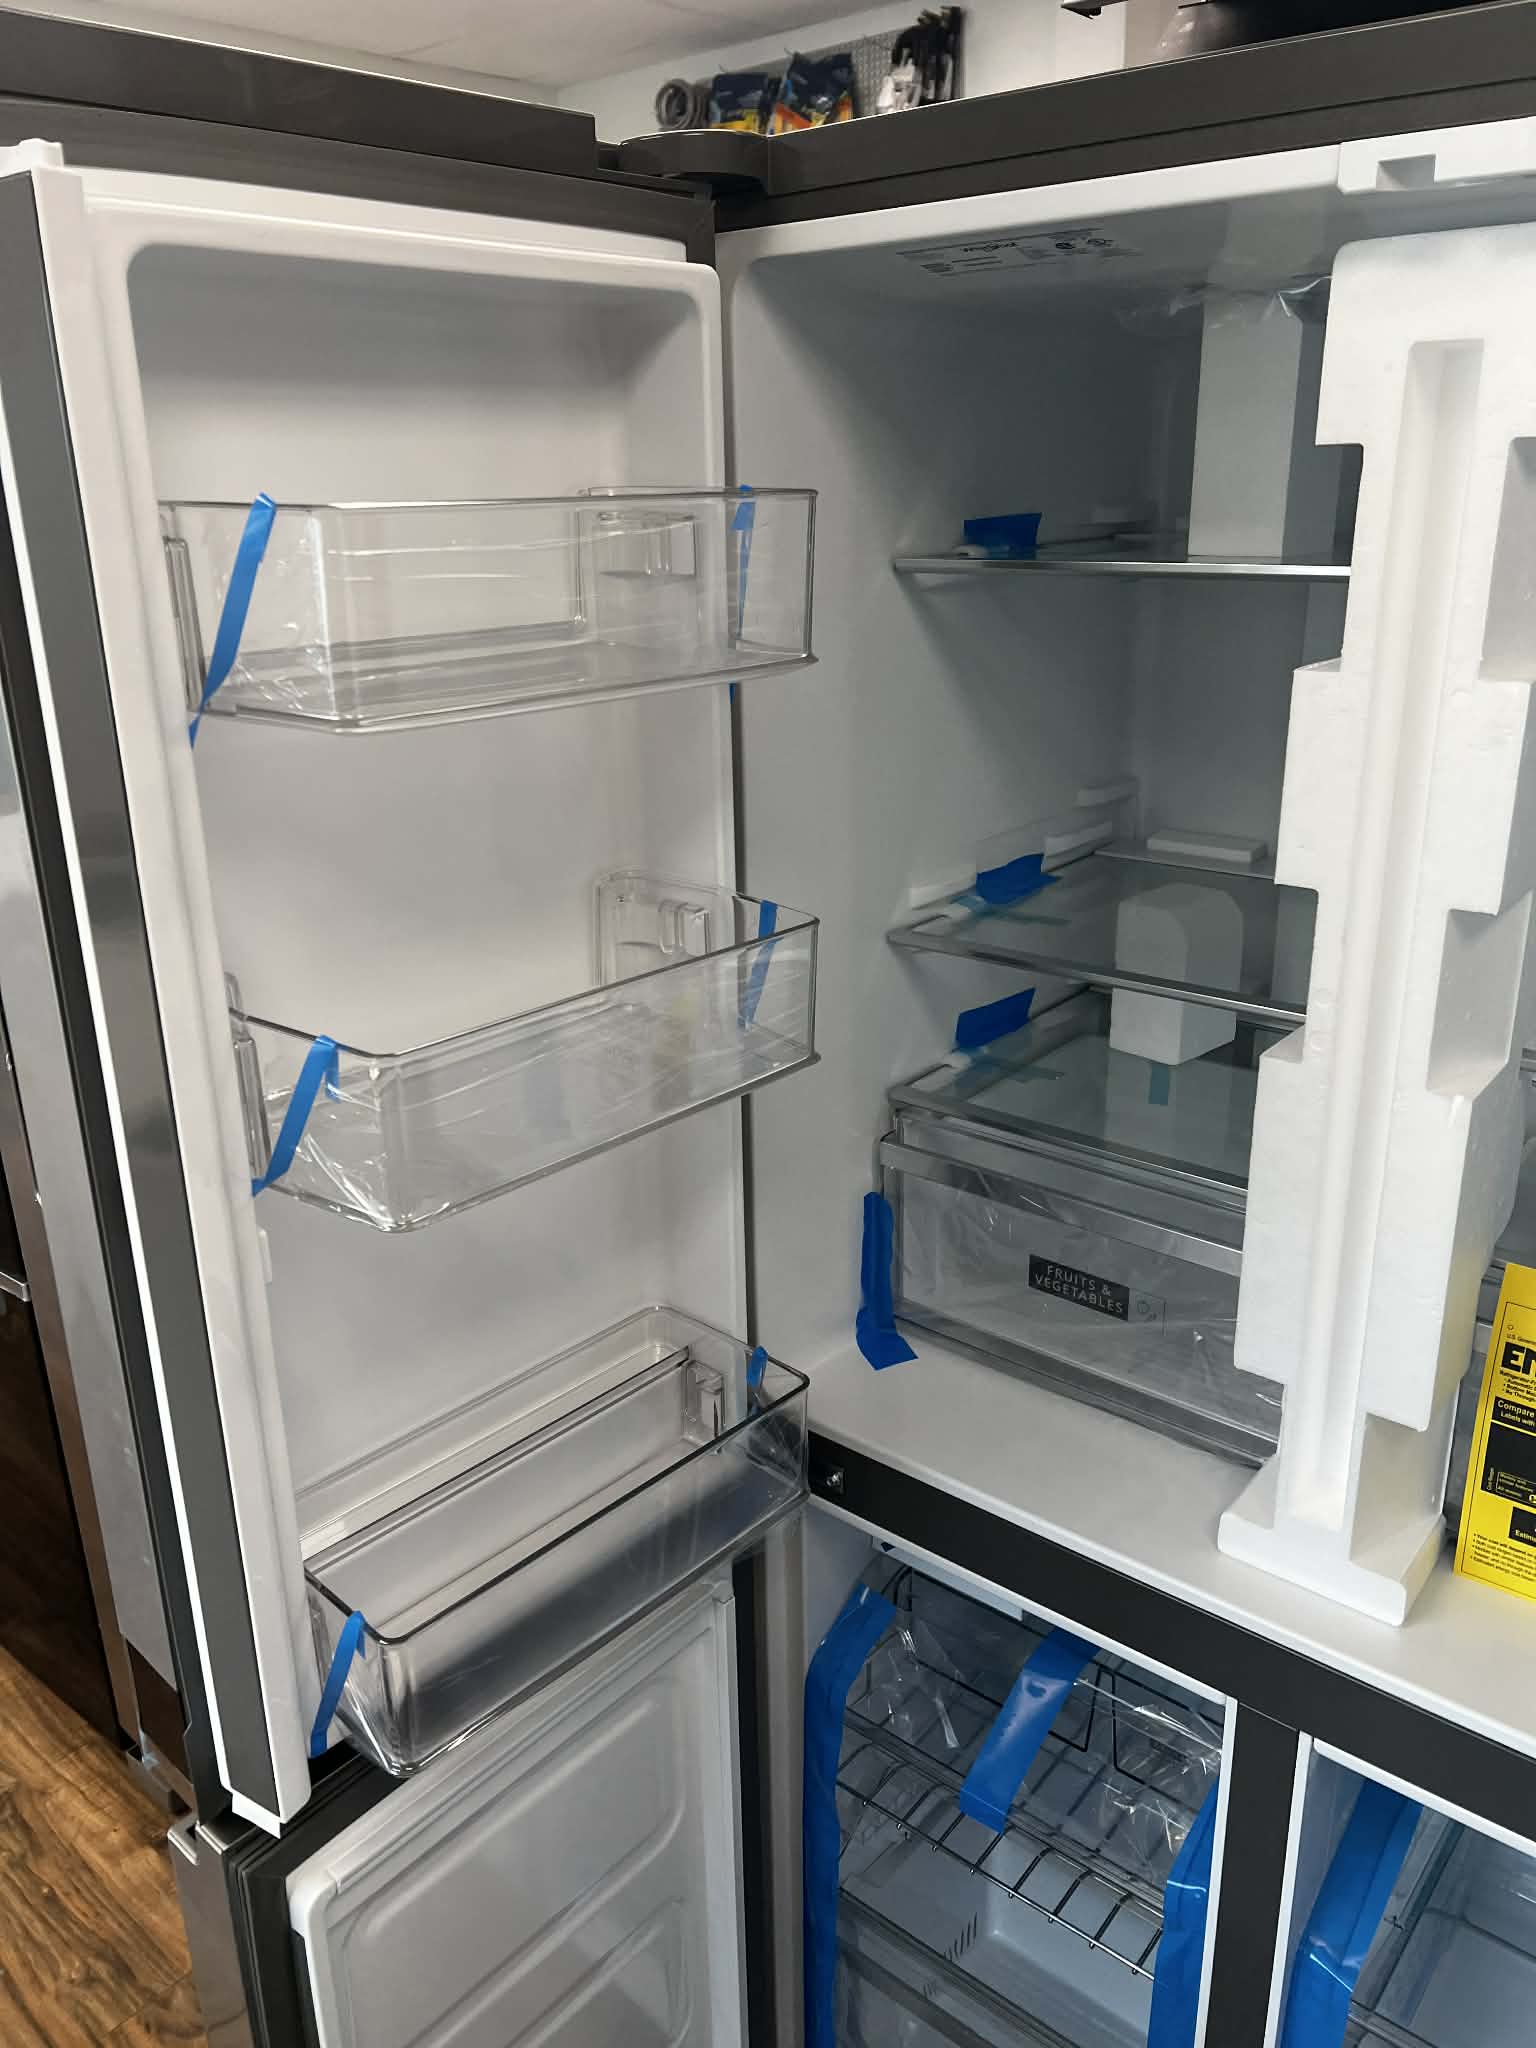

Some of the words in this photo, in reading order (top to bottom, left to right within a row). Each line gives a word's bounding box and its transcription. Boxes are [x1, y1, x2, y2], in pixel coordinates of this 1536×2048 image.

[1034, 1273, 1123, 1313] VEGETABLES
[1047, 1265, 1096, 1291] FRUITS
[1102, 1284, 1112, 1297] &
[1497, 1400, 1535, 1418] Compare
